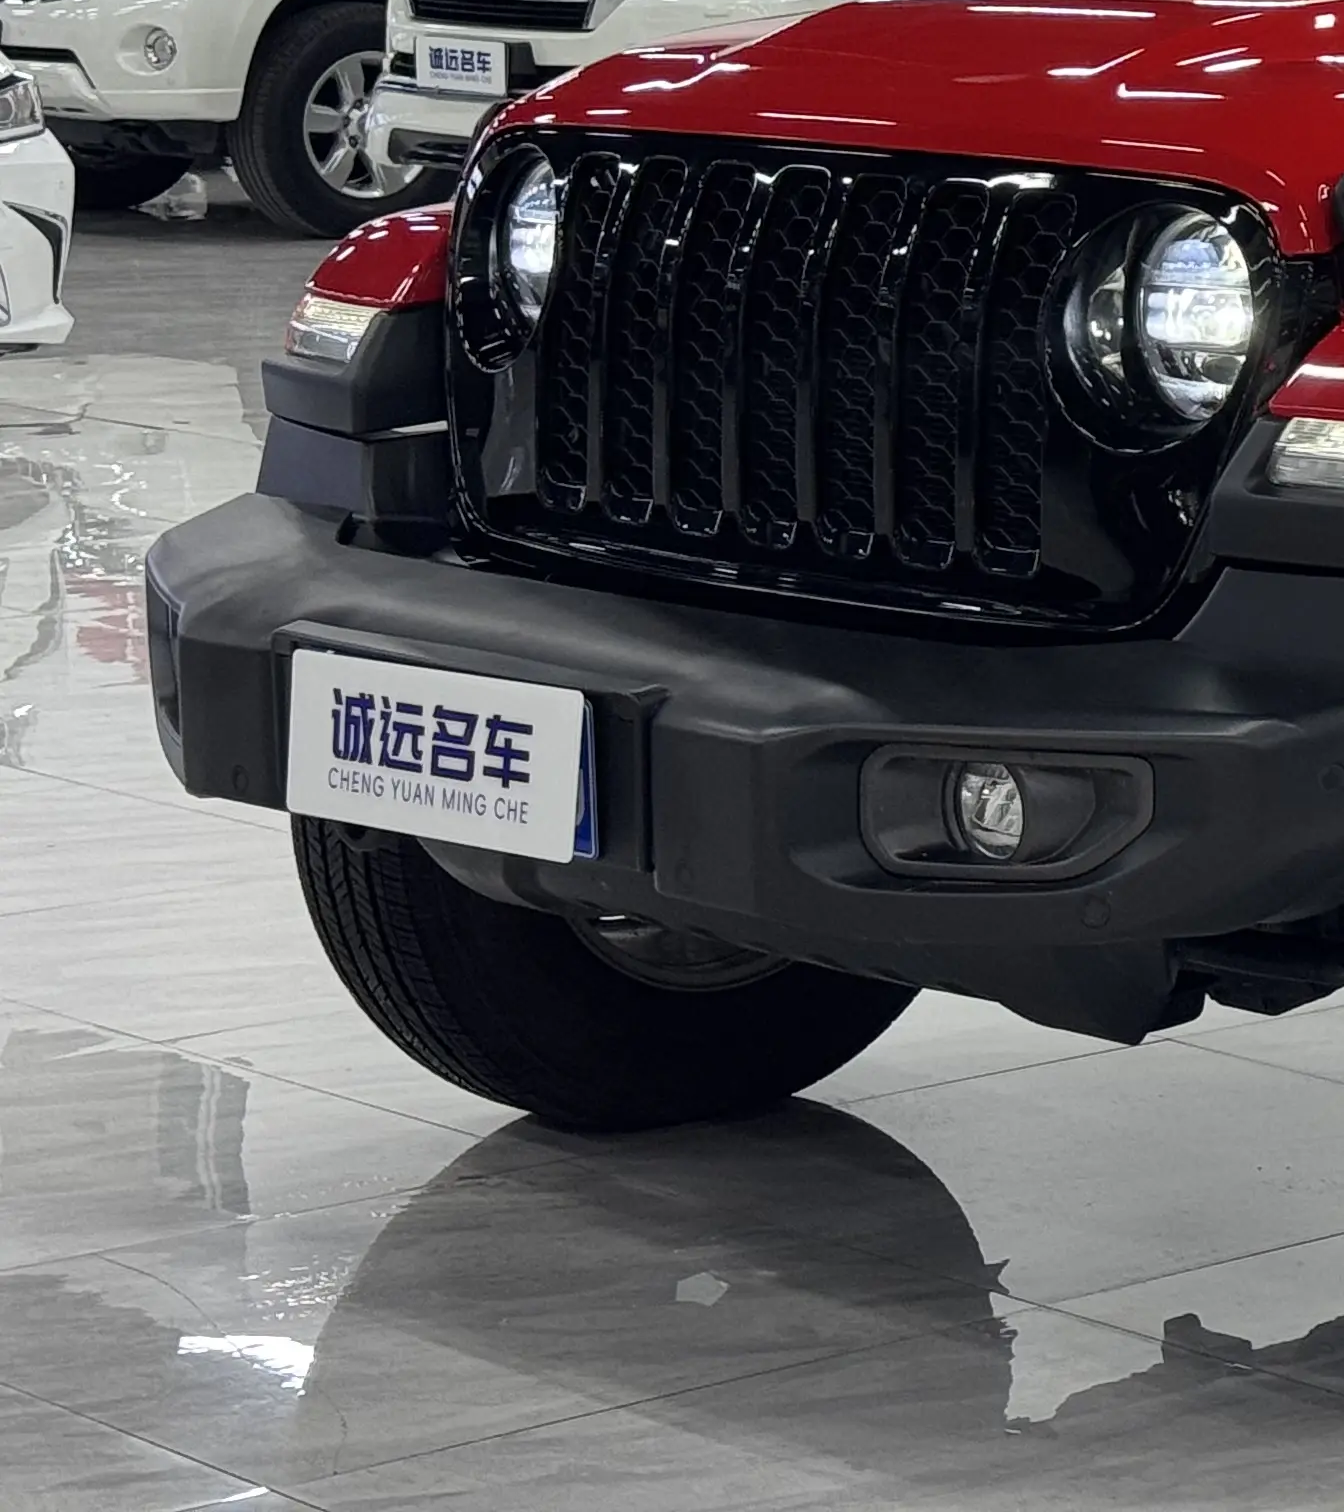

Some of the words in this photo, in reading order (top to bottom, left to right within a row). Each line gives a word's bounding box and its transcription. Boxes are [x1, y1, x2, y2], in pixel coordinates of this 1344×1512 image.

[429, 45, 492, 74] 诚远名车
[331, 687, 534, 789] 诚远名车
[327, 767, 385, 799] CHENG
[391, 778, 435, 807] YUAN
[441, 788, 487, 817] MING
[493, 797, 529, 825] CHE
